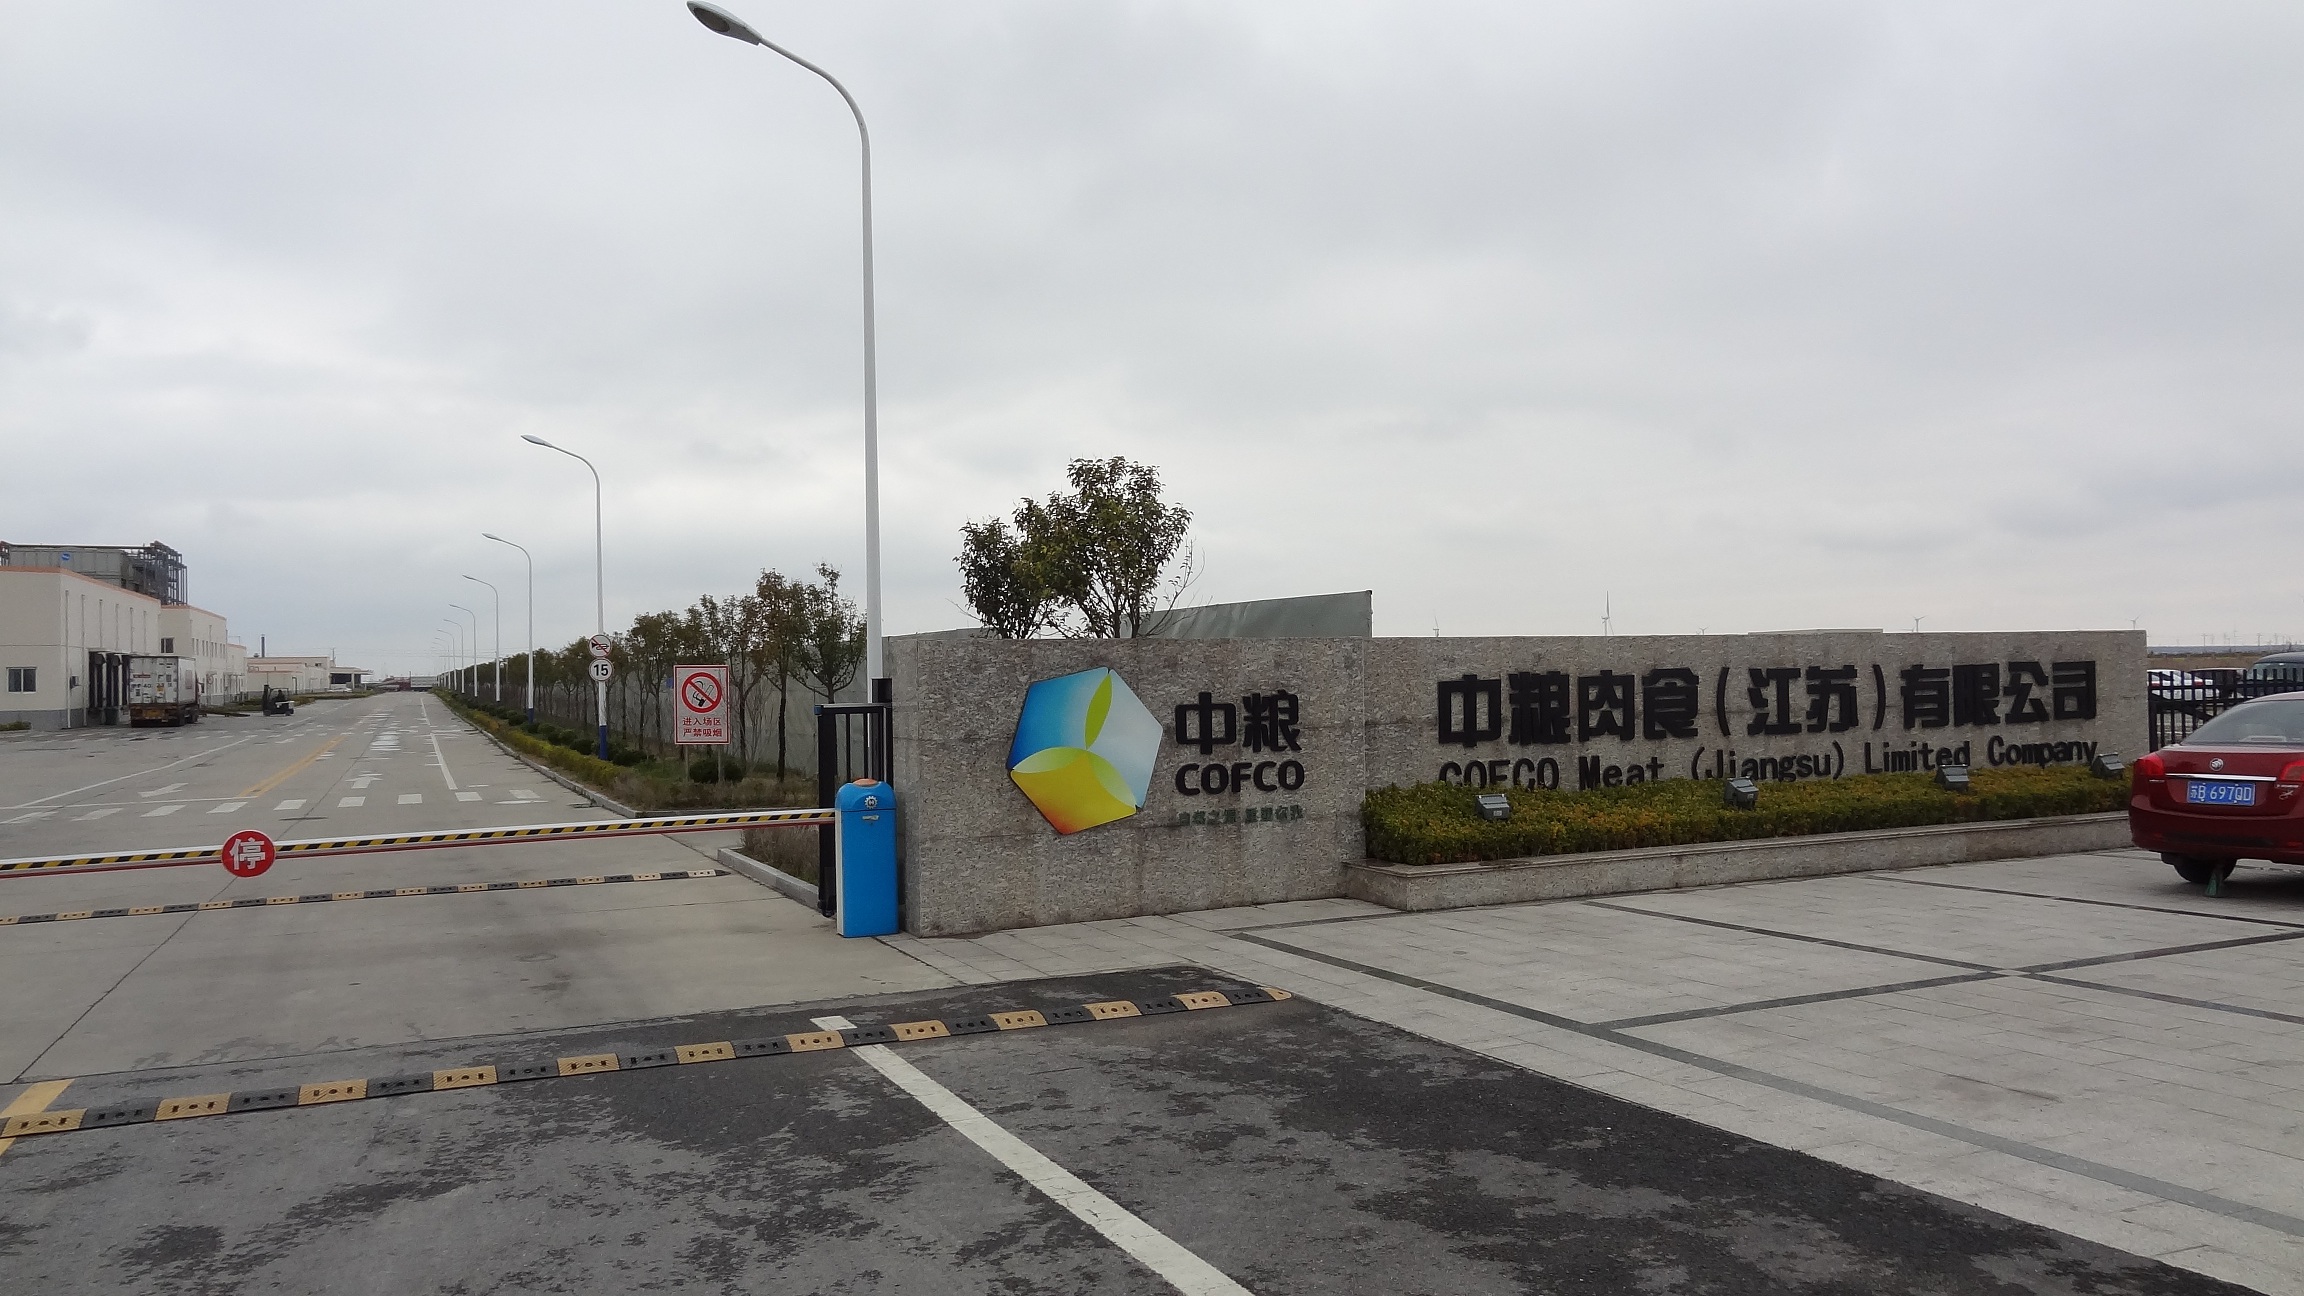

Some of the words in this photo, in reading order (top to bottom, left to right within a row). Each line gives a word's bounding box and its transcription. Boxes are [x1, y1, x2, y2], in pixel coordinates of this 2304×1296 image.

[593, 663, 609, 677] 15
[1437, 660, 2098, 748] 中粮肉食（江苏）有限公司
[682, 717, 722, 727] 进入场区
[682, 728, 723, 738] 严禁吸烟
[1174, 690, 1303, 755] 中粮
[1174, 760, 1306, 796] COFCO
[1439, 757, 1560, 793] COFCO
[1578, 755, 1665, 792] Meat
[1691, 739, 1845, 782] (Jiangsu)
[1864, 740, 1971, 775] Limited
[1987, 735, 2098, 769] Company
[229, 837, 266, 870] 停
